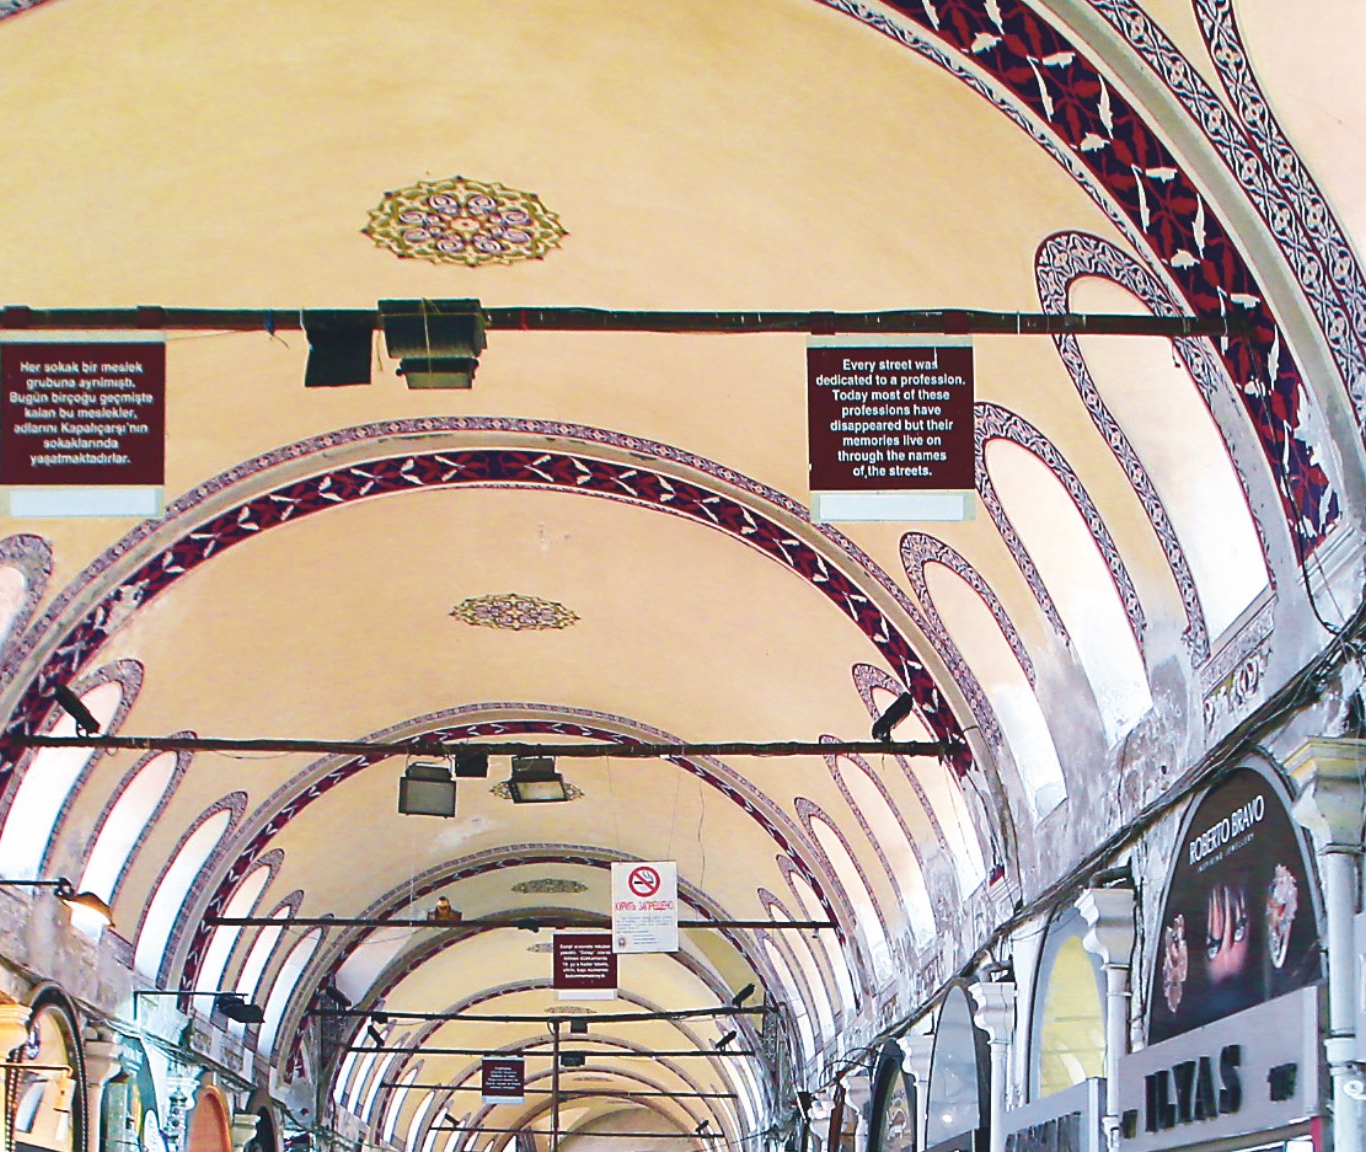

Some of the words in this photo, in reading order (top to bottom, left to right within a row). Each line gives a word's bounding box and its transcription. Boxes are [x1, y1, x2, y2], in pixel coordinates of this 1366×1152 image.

[21, 362, 40, 372] Her
[44, 362, 78, 372] sokak
[82, 362, 97, 372] bir
[101, 362, 143, 372] meslek
[843, 359, 875, 373] Every
[879, 360, 912, 370] street
[915, 361, 938, 369] was
[27, 377, 75, 390] grubuna
[816, 374, 872, 386] dedicated
[876, 376, 887, 386] to
[890, 378, 897, 386] a
[901, 374, 965, 387] profession.
[10, 392, 48, 405] Bugün
[100, 393, 153, 405] geçmişte
[833, 390, 867, 402] Today
[871, 391, 900, 401] most
[904, 390, 915, 401] of
[918, 390, 950, 400] these
[25, 408, 56, 418] kalan
[59, 408, 74, 418] bu
[842, 405, 910, 418] professions
[914, 405, 941, 415] have
[14, 423, 57, 433] adlarını
[830, 420, 902, 433] disappeared
[905, 420, 924, 431] but
[927, 420, 953, 431] their
[43, 438, 118, 448] sokaklarında
[843, 435, 899, 446] memories
[903, 435, 923, 446] live
[927, 437, 941, 445] on
[838, 450, 883, 463] through
[887, 451, 905, 461] the
[908, 452, 947, 461] names
[868, 466, 886, 476] the
[889, 466, 932, 476] streets.
[1189, 819, 1230, 865] ROBERTO
[1232, 795, 1265, 838] BRAVO
